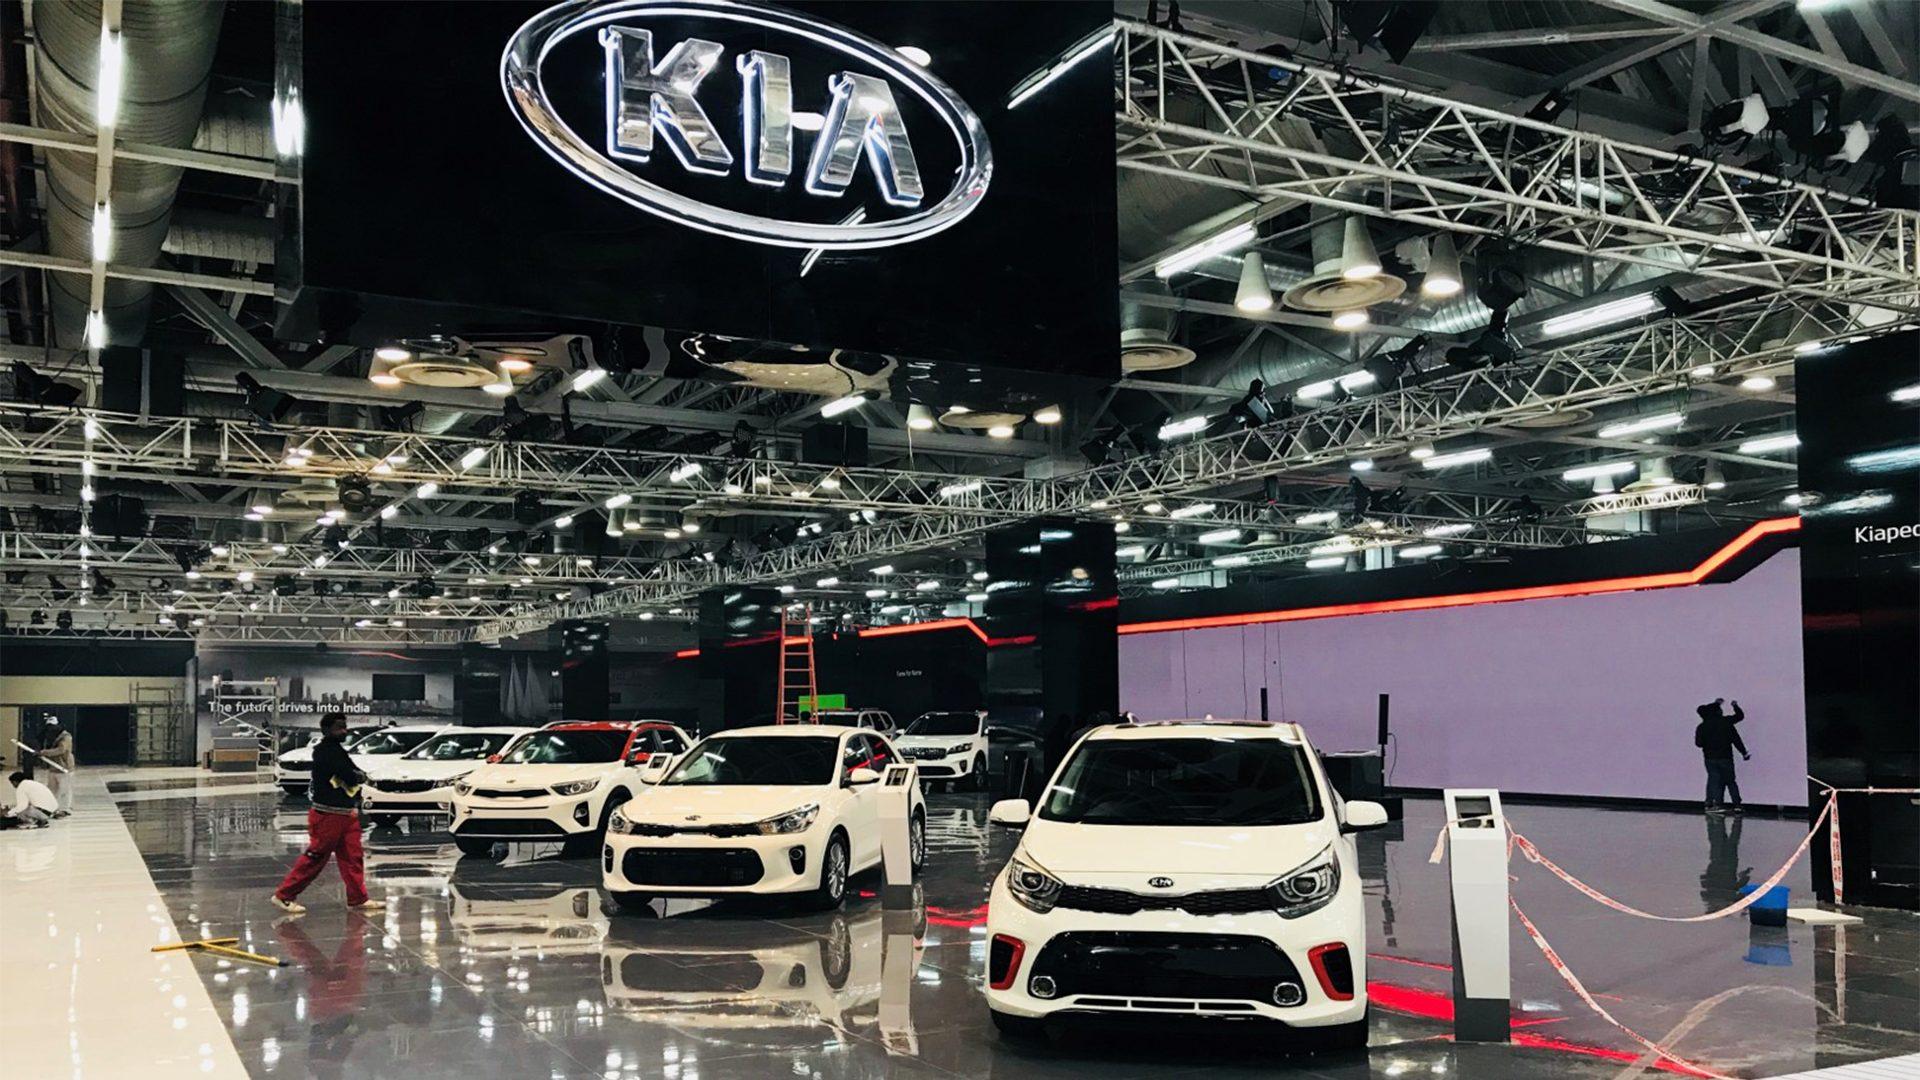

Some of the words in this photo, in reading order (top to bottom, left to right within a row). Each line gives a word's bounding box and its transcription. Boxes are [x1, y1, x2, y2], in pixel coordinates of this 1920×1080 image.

[598, 25, 924, 207] KIA
[208, 701, 232, 713] The
[236, 701, 275, 713] future
[278, 701, 313, 713] drives
[317, 701, 340, 713] into
[343, 702, 371, 713] India
